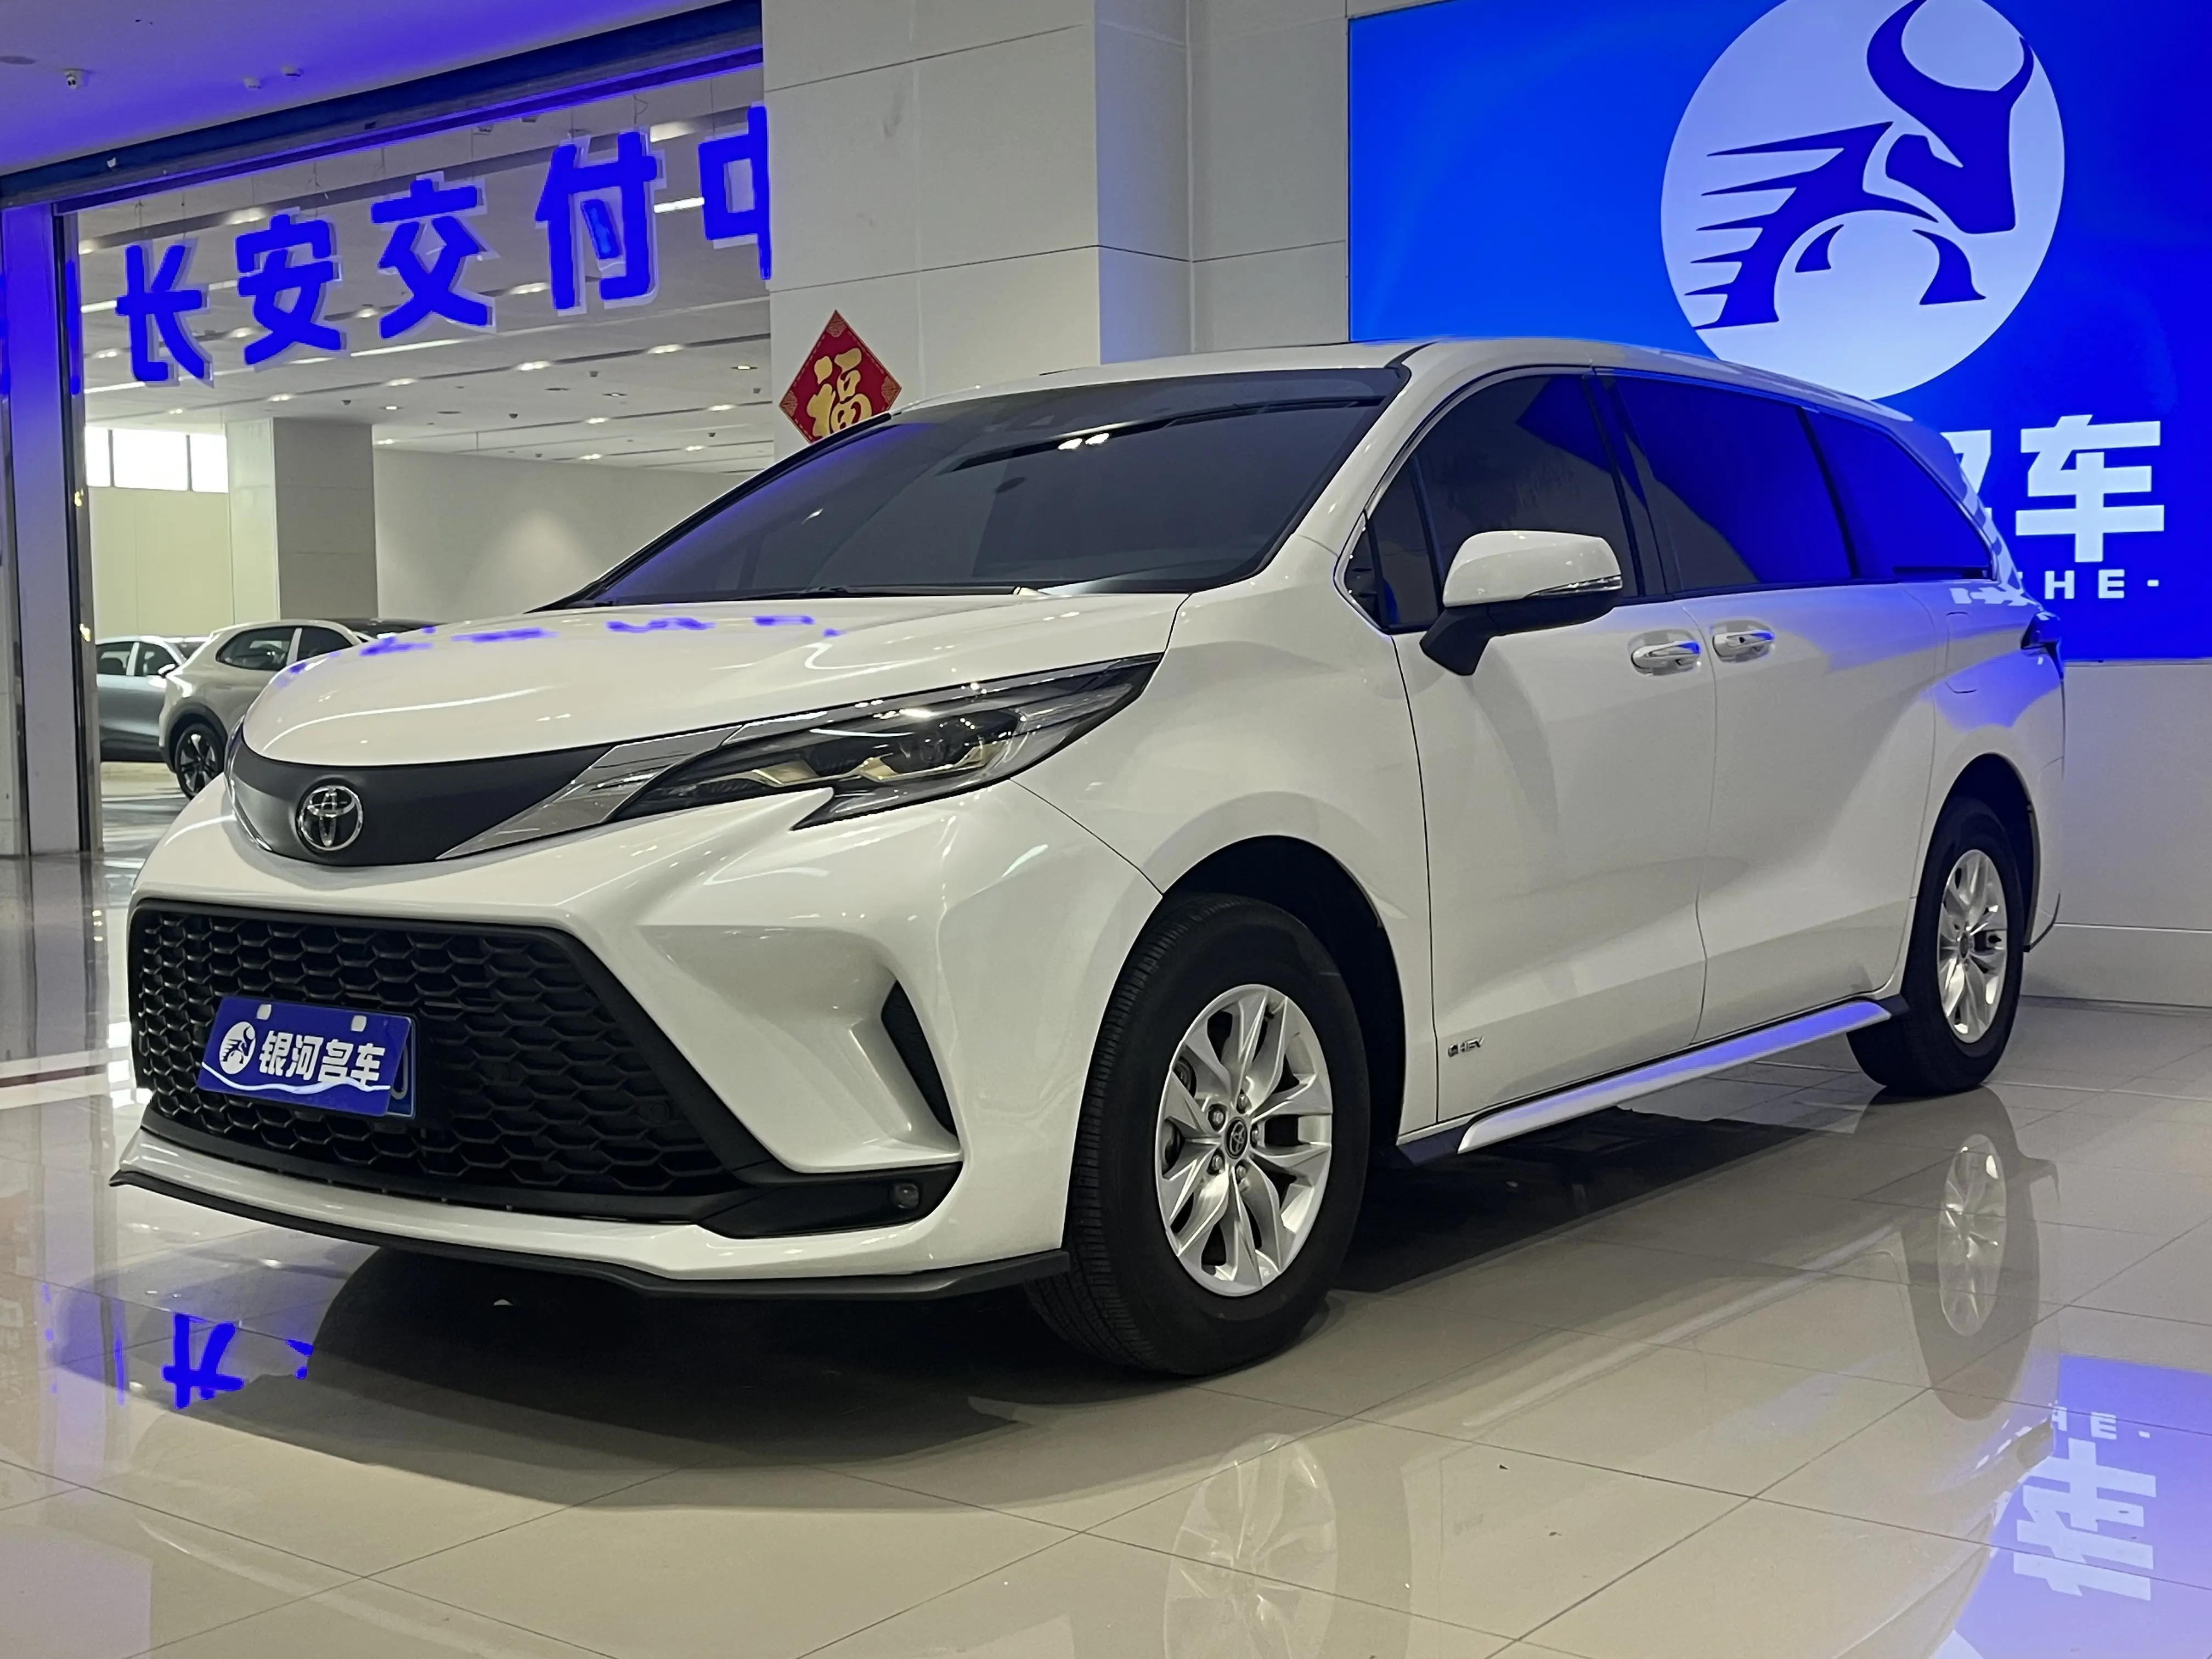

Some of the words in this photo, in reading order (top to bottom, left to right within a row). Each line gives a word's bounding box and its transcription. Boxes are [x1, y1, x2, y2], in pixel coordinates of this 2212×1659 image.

[807, 348, 872, 438] 福
[259, 1030, 385, 1087] 银河名车
